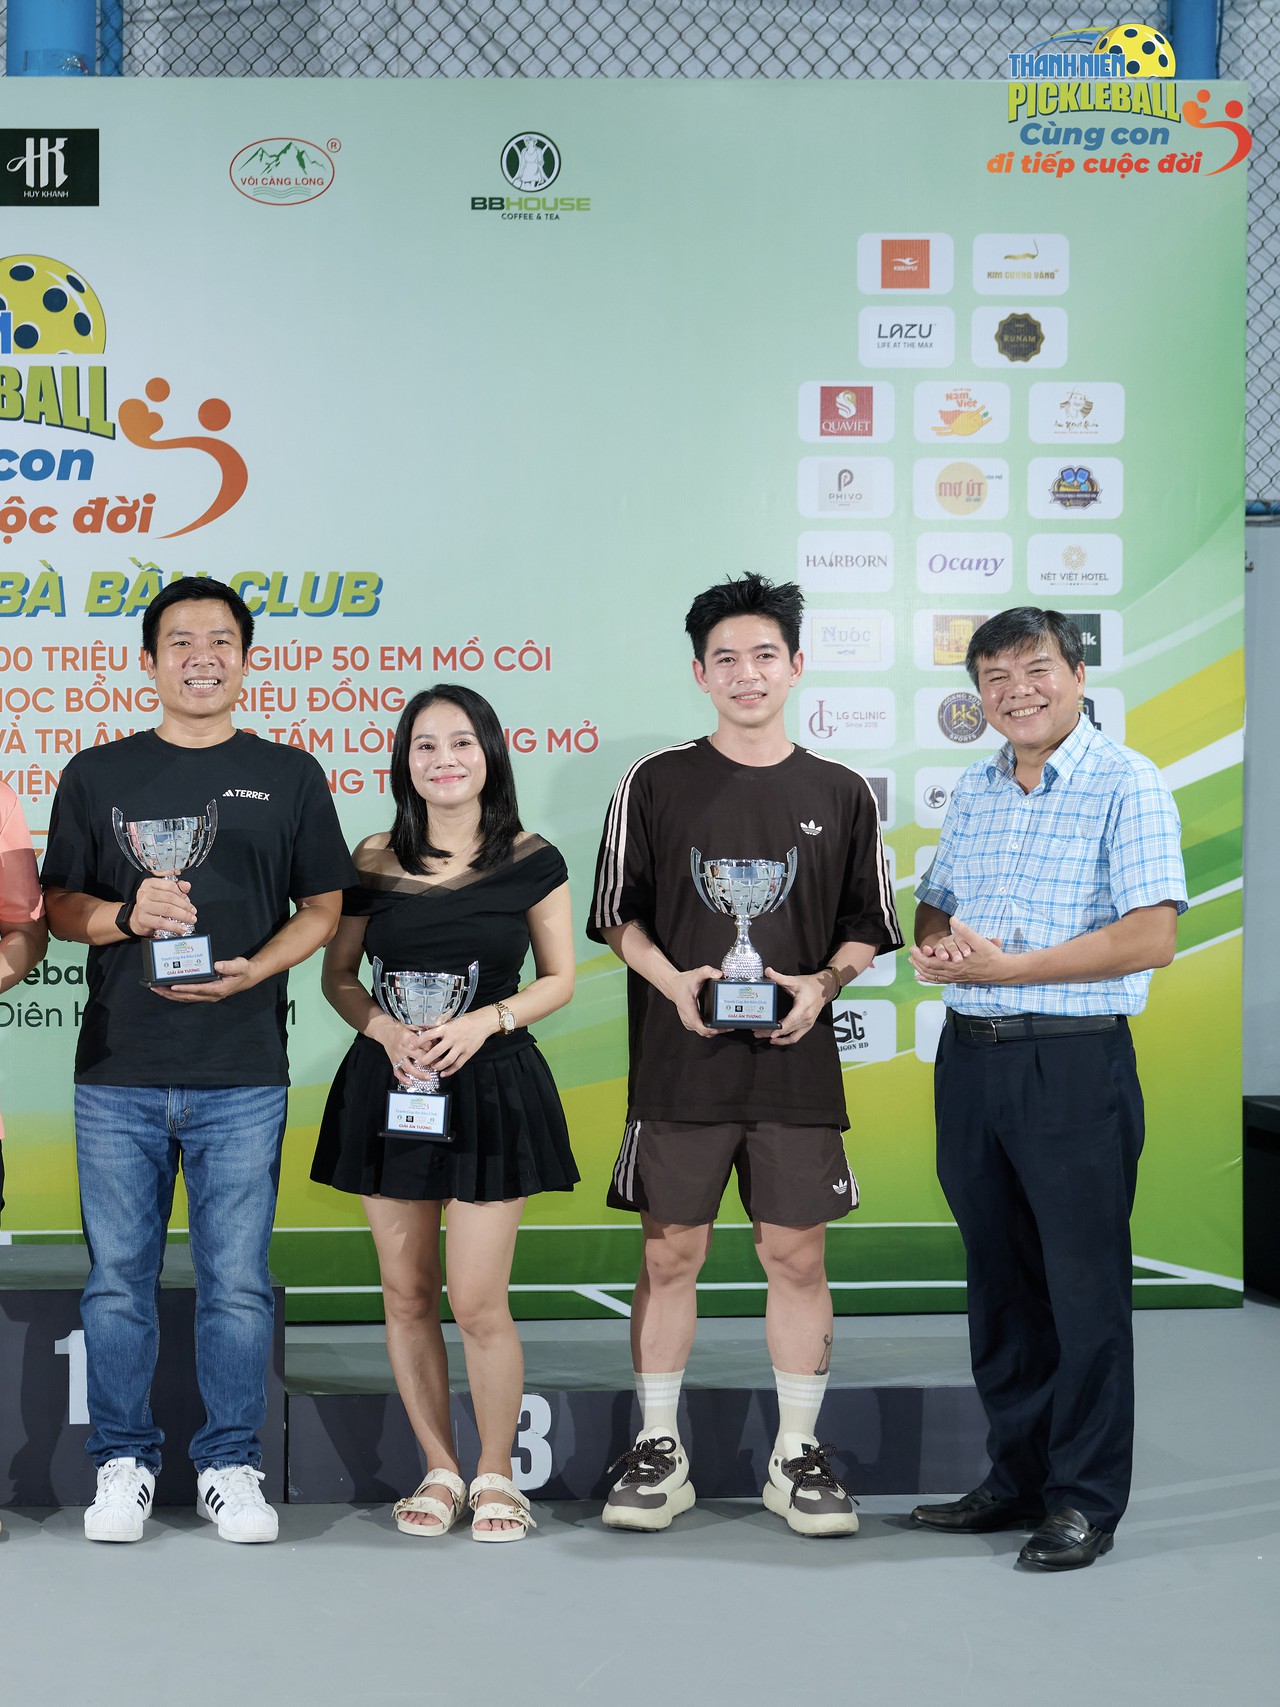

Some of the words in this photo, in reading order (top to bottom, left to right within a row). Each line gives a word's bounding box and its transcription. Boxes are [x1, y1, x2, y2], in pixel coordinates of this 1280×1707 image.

[295, 177, 324, 186] LONG
[471, 197, 591, 211] BBHOUSE
[987, 271, 1002, 279] KIM
[877, 324, 933, 338] LAZU
[1003, 334, 1036, 342] RUNAM
[821, 421, 871, 433] QUAVIET
[72, 493, 157, 534] đời
[928, 553, 1005, 577] Ocany
[1081, 573, 1109, 581] HOTEL
[84, 556, 195, 618] BẦ
[229, 571, 384, 617] CLUB
[42, 639, 128, 680] TRIỆU
[249, 639, 323, 672] GIÚP
[332, 646, 370, 672] 50
[380, 646, 422, 671] EM
[433, 636, 484, 672] MỒ
[494, 640, 551, 672] CÔI
[65, 674, 160, 713] BỔNG
[231, 680, 296, 719] RIỆU
[307, 676, 406, 713] ĐỒNG
[836, 712, 849, 720] LG
[852, 711, 886, 720] CLINIC
[35, 729, 81, 754] TRI
[269, 719, 333, 753] TẤM
[547, 720, 599, 753] MỞ
[235, 789, 270, 801] TERREX
[54, 1329, 91, 1425] 1
[511, 1394, 553, 1490] 3
